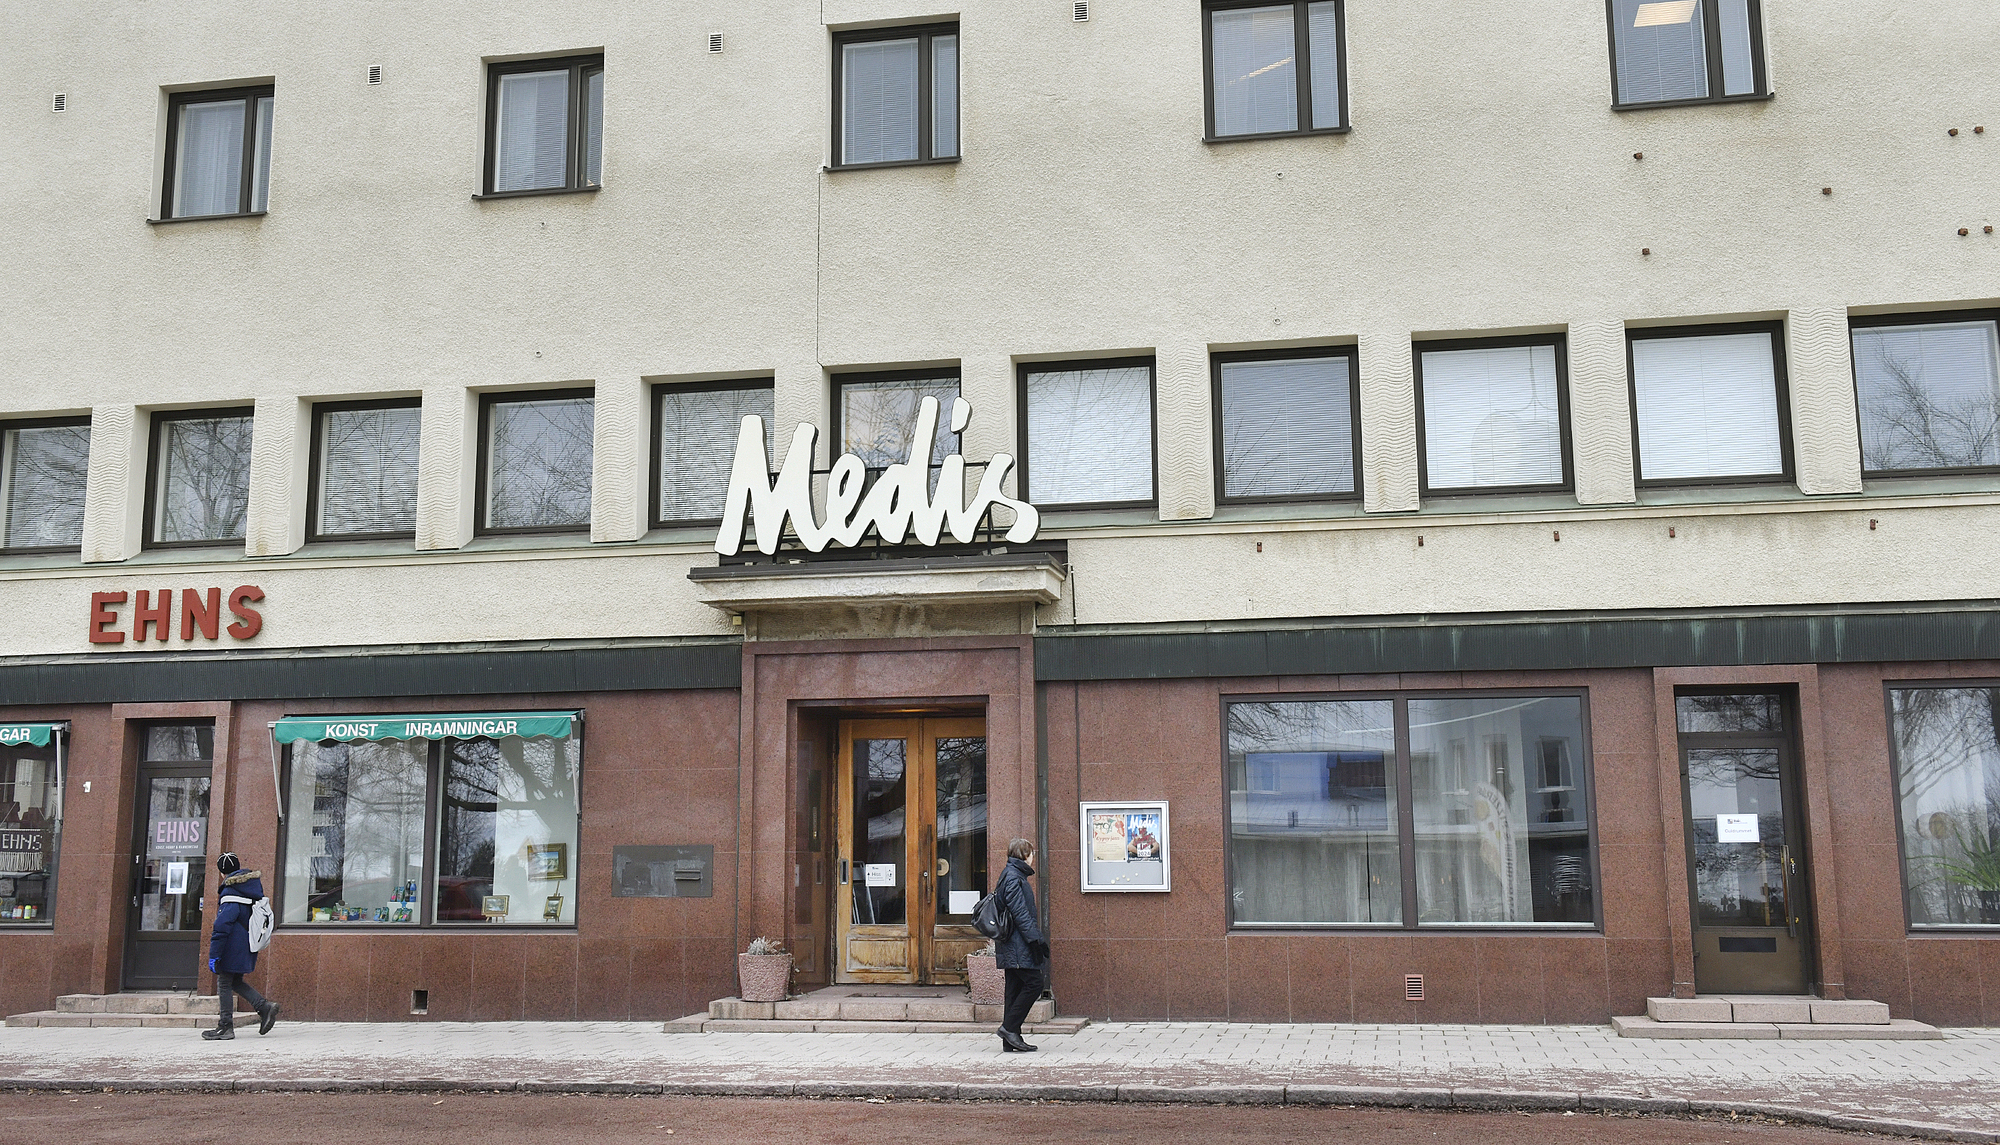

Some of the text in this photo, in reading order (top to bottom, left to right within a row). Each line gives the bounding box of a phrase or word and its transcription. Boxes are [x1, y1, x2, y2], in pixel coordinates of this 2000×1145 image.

[714, 396, 1041, 556] Medis
[89, 585, 265, 643] EHNS
[0, 728, 31, 741] GAR
[325, 721, 517, 737] KONST INRAMNINGAR
[1128, 814, 1157, 829] Medis
[157, 820, 200, 843] EHNS
[2, 833, 43, 851] EHNS
